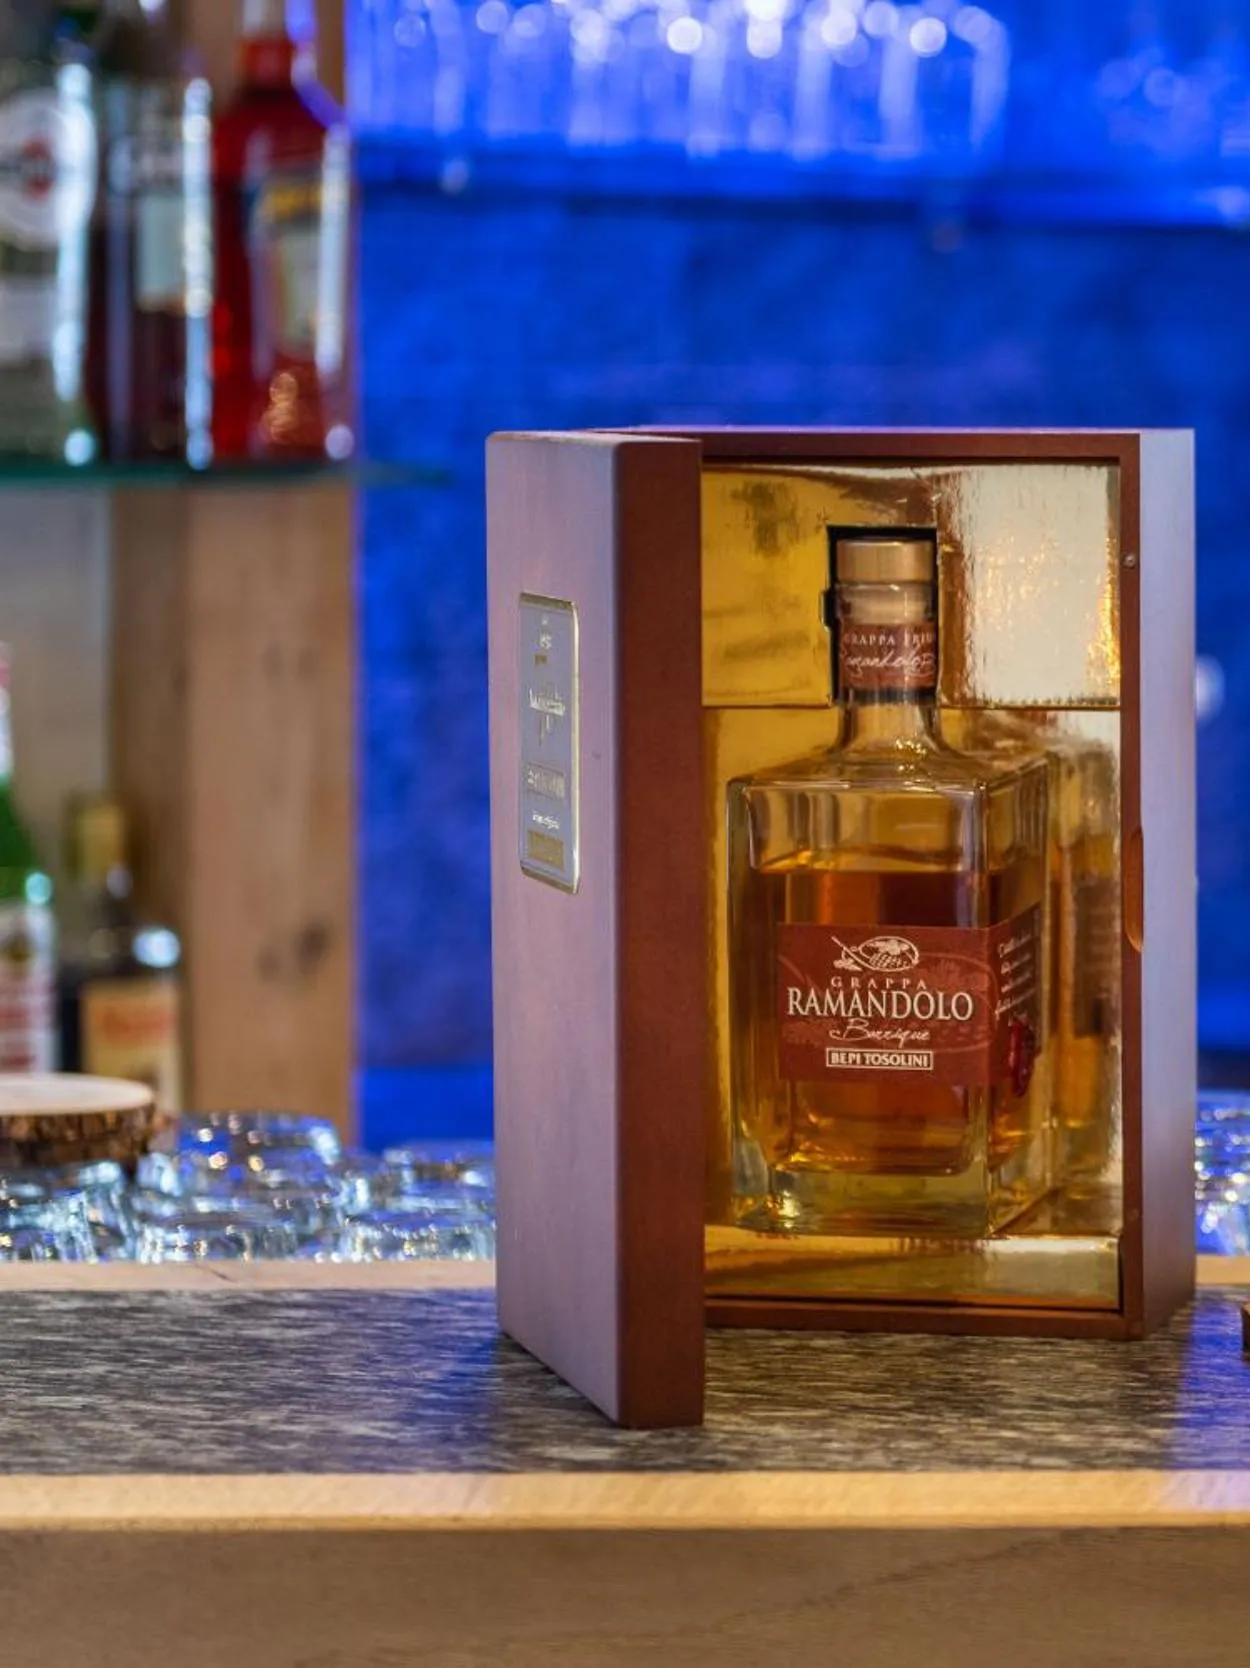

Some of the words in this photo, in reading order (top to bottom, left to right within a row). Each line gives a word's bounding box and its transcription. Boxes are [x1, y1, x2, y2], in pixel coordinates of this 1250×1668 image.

[830, 976, 927, 990] GRAPPA
[787, 987, 974, 1021] RAMANDOLO
[831, 1052, 861, 1065] BEPI
[863, 1053, 928, 1068] TOSOLINI
